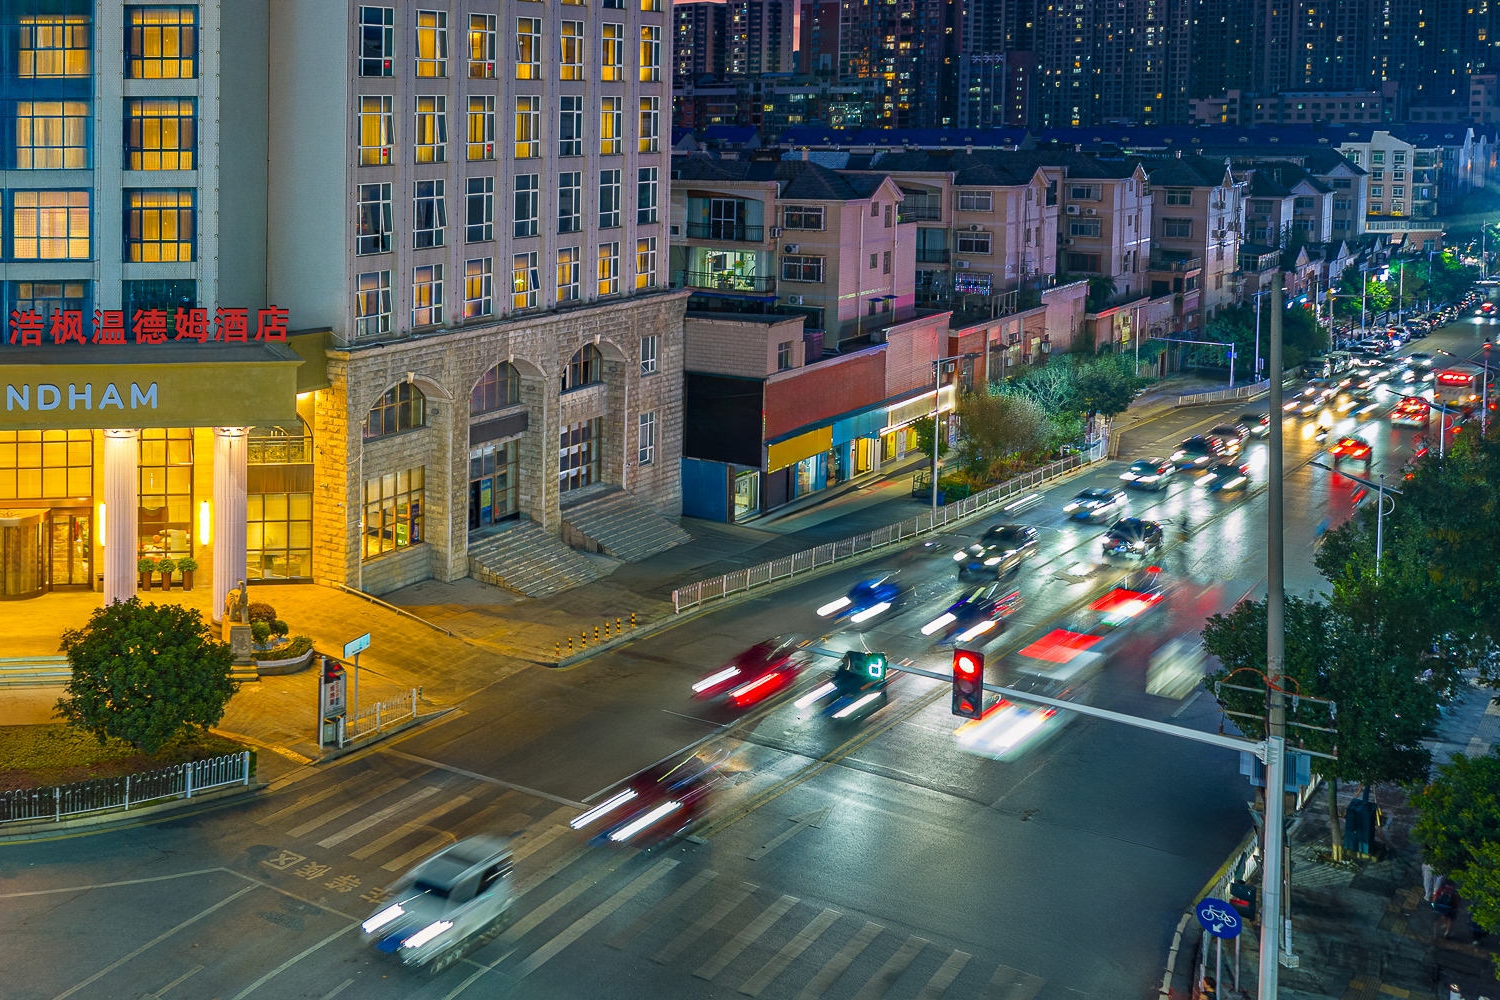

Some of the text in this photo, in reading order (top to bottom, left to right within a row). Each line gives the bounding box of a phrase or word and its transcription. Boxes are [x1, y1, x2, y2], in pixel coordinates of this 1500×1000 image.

[8, 304, 290, 346] 浩枫温德姆酒店
